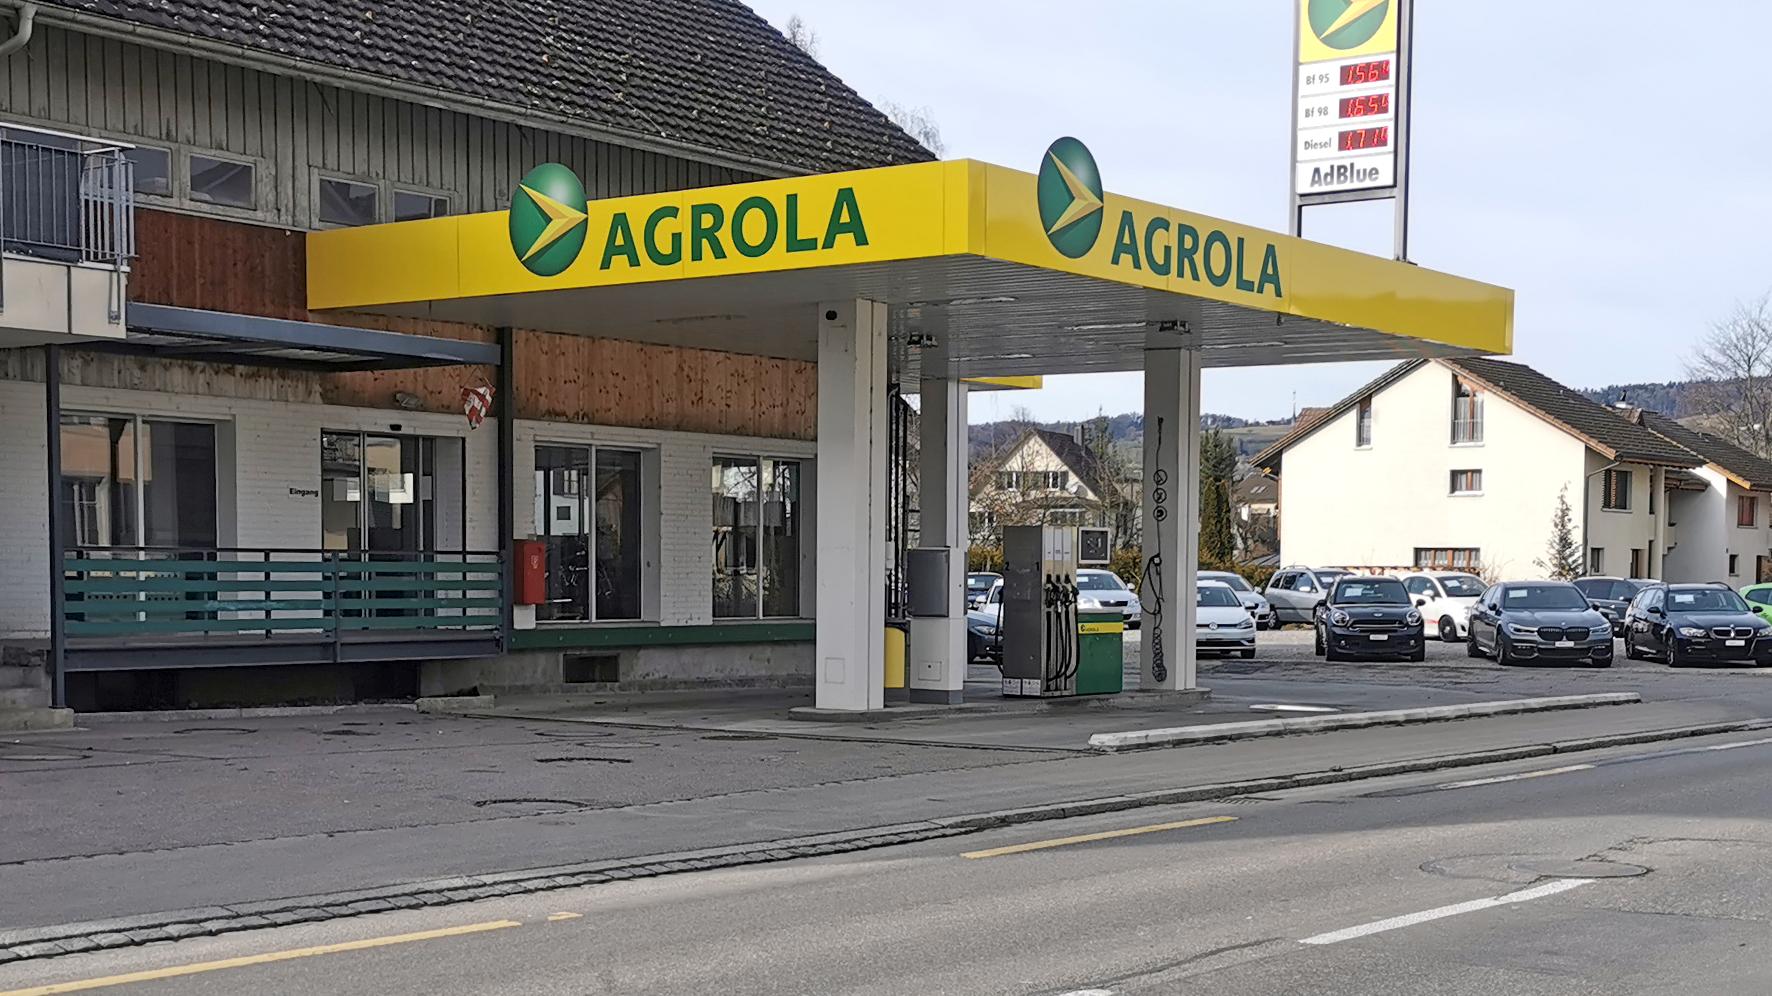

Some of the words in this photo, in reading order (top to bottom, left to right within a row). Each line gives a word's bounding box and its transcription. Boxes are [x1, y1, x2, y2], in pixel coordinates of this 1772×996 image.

[1306, 74, 1315, 85] Bf
[1318, 73, 1329, 84] 95
[1305, 106, 1315, 118] Bf
[1317, 106, 1328, 117] 98
[1304, 137, 1332, 150] Diesel
[1310, 163, 1379, 187] AdBlue
[600, 187, 869, 270] AGROLA
[1111, 210, 1282, 298] AGROLA
[289, 488, 318, 497] Eingang
